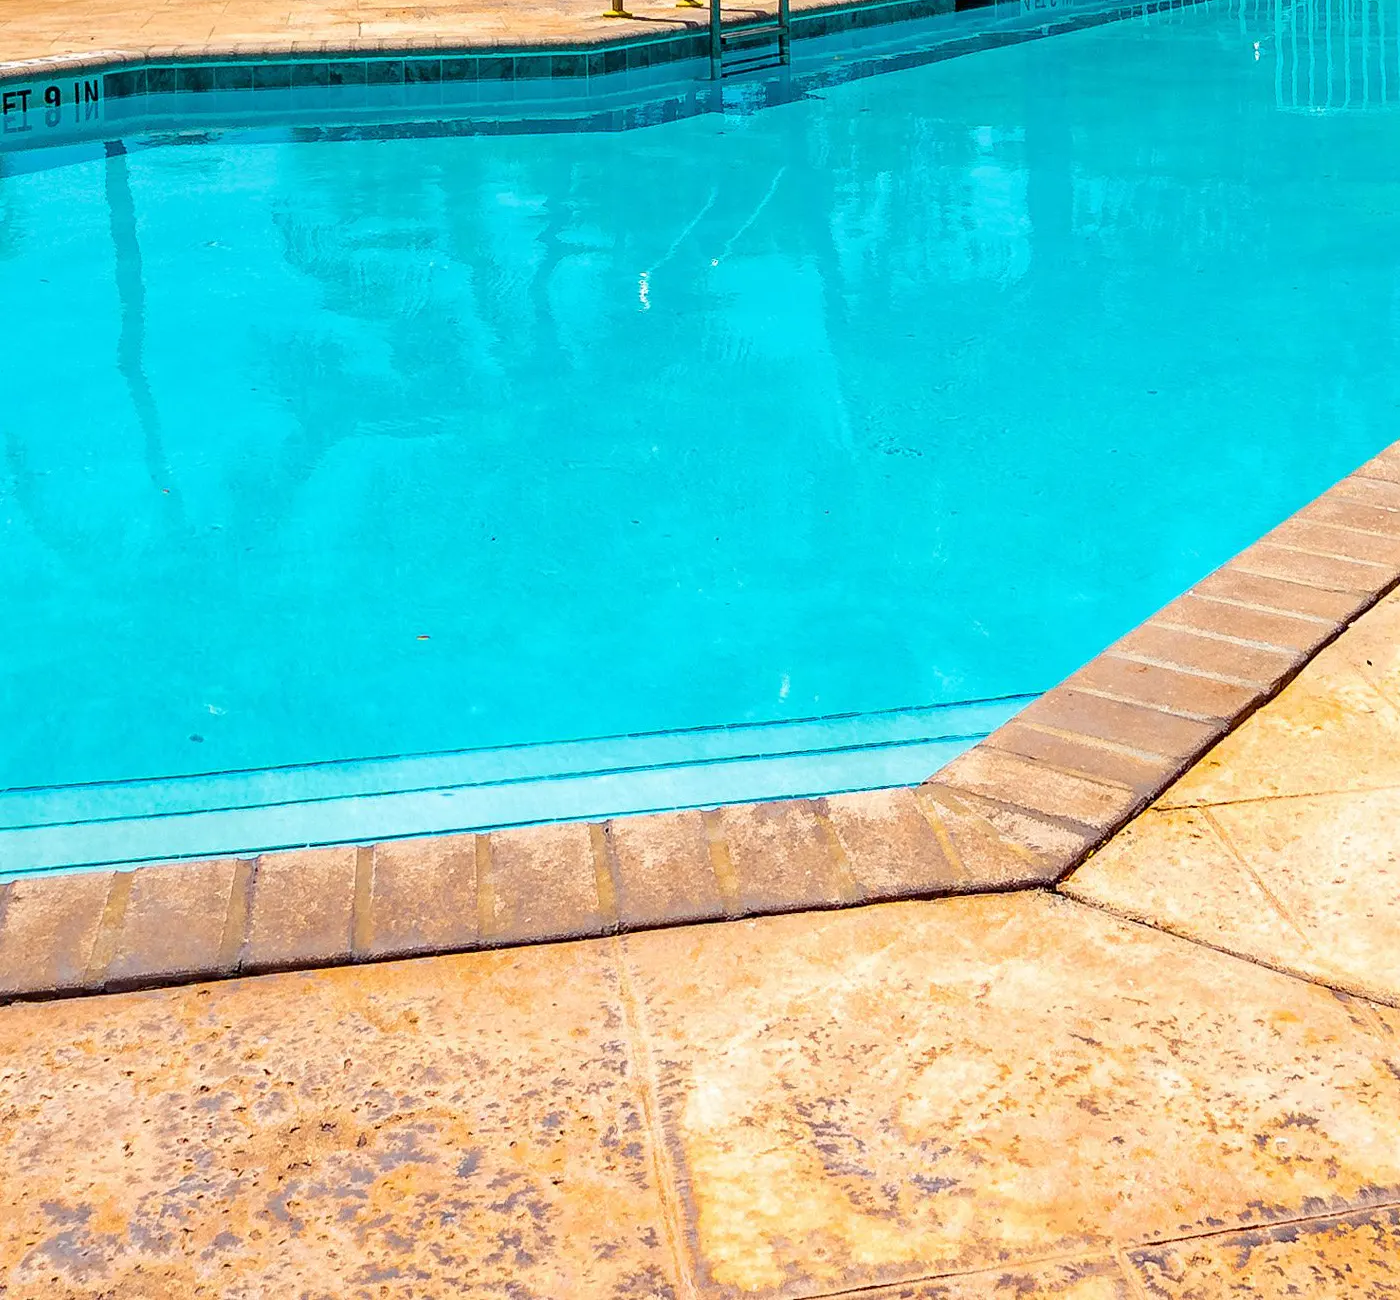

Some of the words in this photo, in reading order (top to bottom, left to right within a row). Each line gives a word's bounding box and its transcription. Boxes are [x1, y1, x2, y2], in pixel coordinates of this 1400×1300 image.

[2, 89, 32, 115] FT
[44, 85, 61, 108] 9
[74, 79, 99, 105] IN
